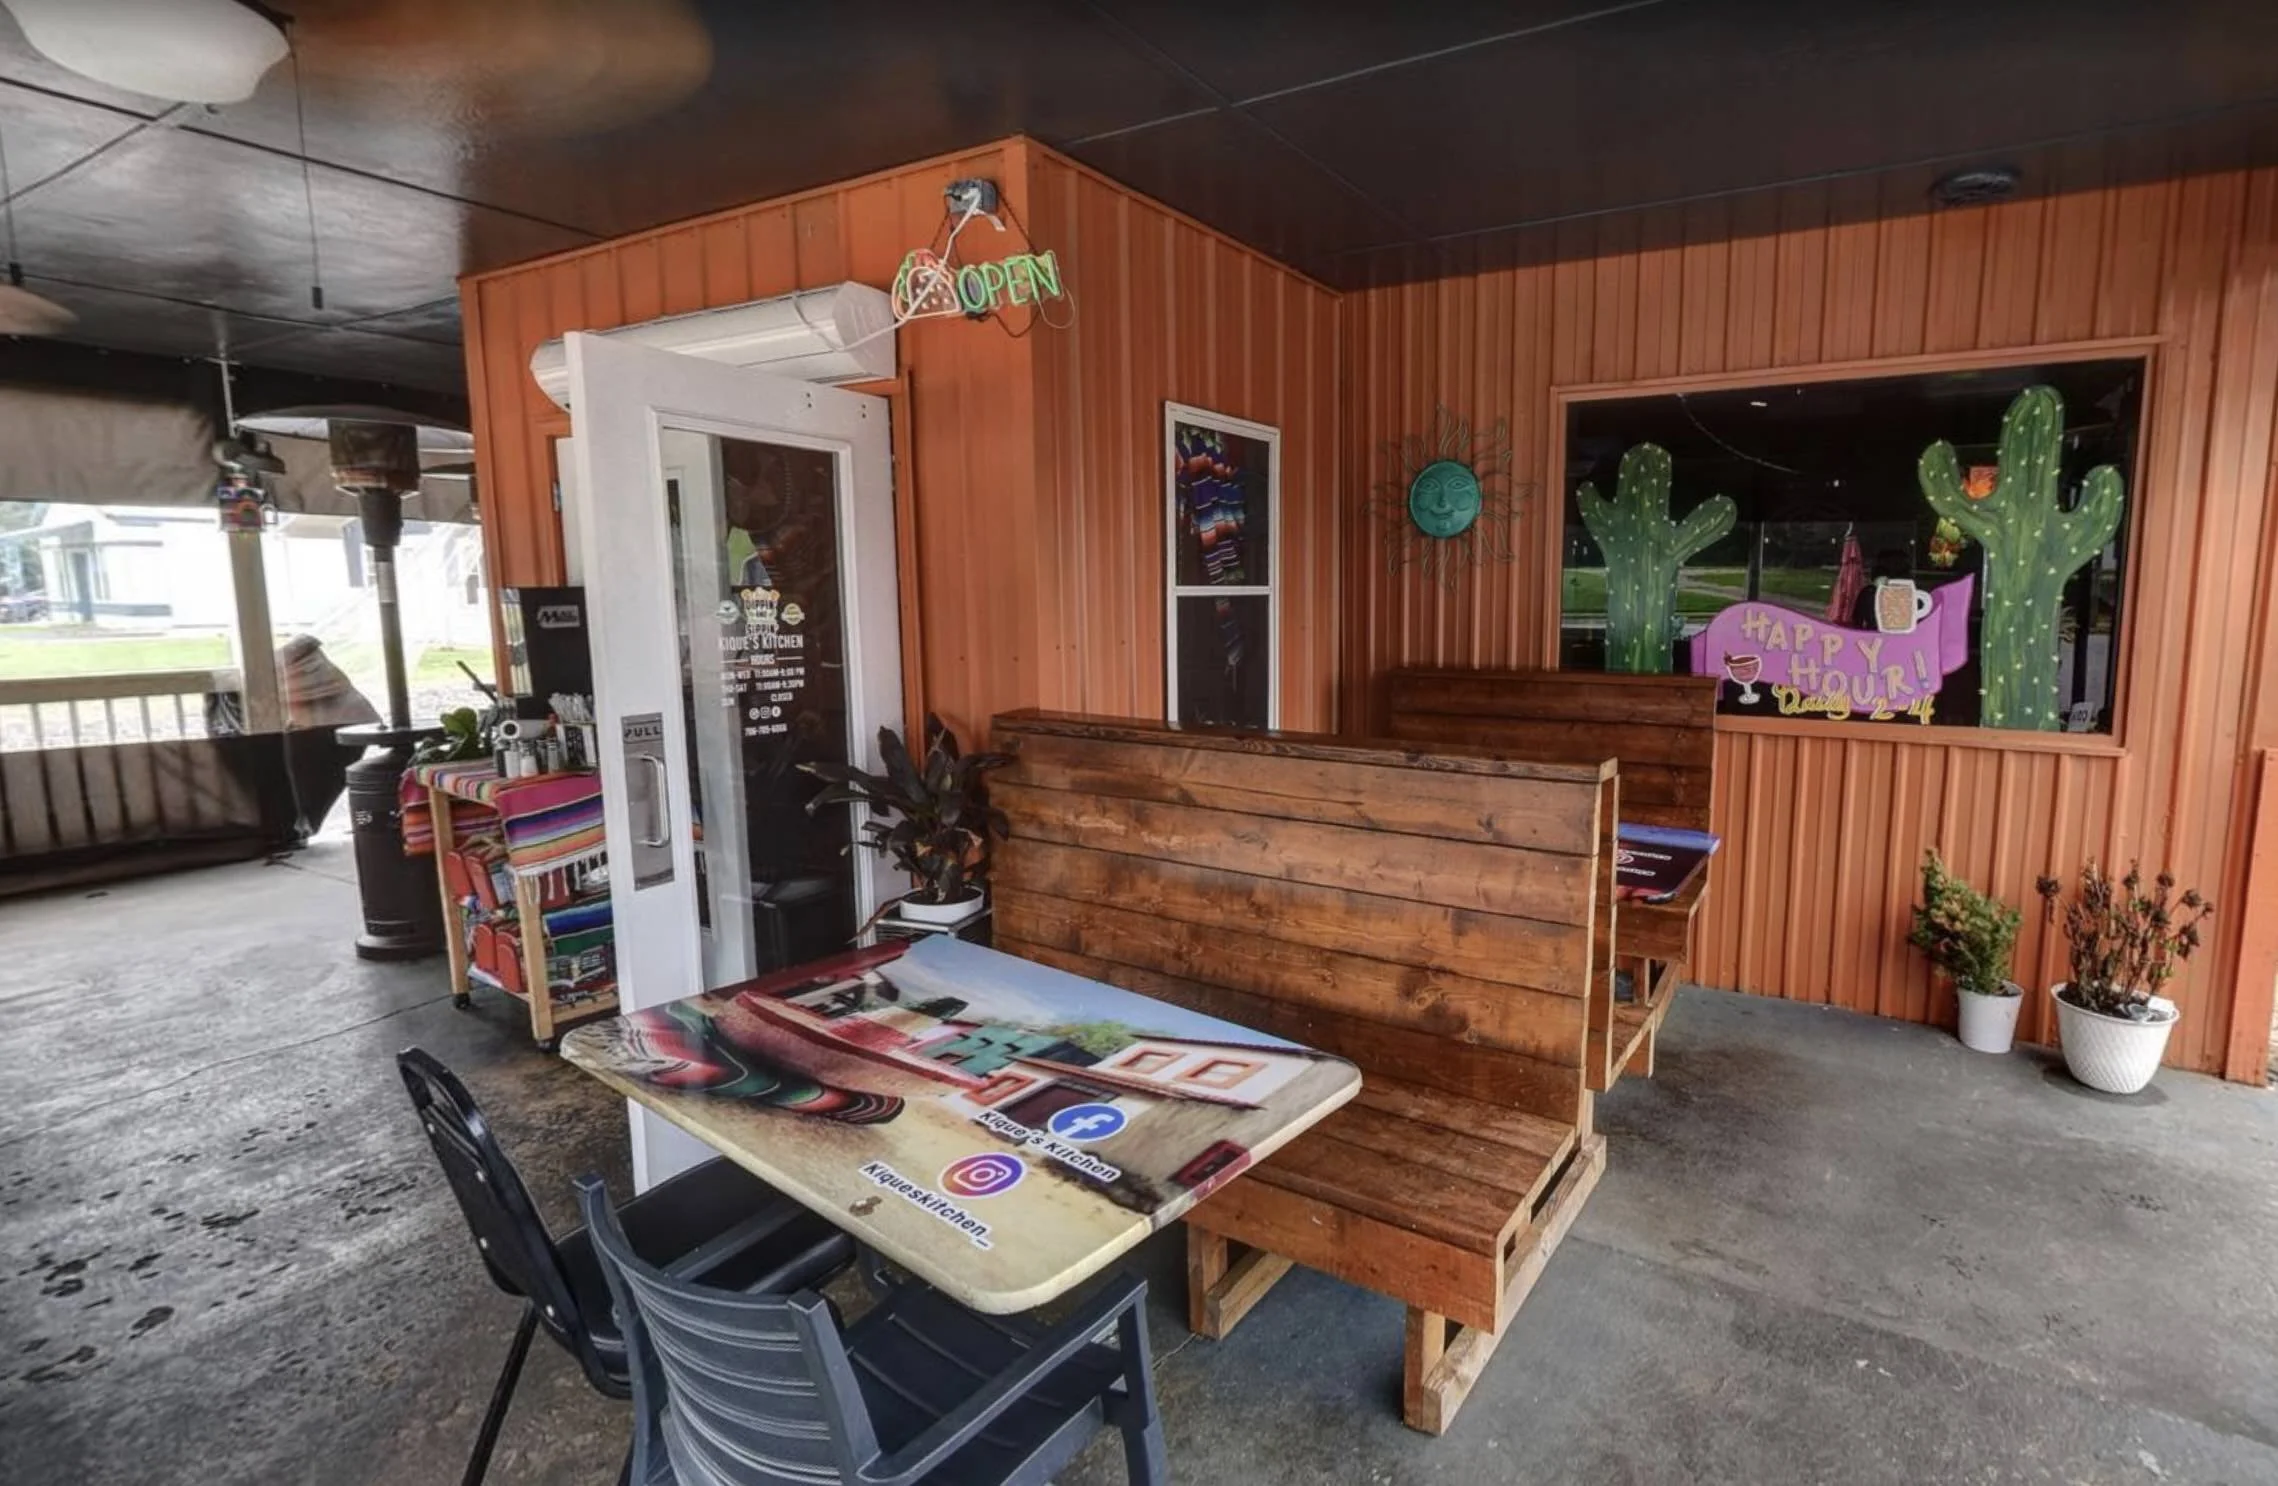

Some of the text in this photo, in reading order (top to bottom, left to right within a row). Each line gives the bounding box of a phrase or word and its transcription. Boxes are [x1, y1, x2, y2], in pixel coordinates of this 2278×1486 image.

[957, 250, 1062, 309] OPEN
[719, 633, 804, 651] KIQUE'S KITCHEN
[1741, 608, 1883, 673] HAPPY
[1787, 649, 1931, 705] HOUR!
[1771, 683, 1851, 721] Daily
[623, 726, 662, 739] PULL
[1045, 1142, 1116, 1179] Kitchen
